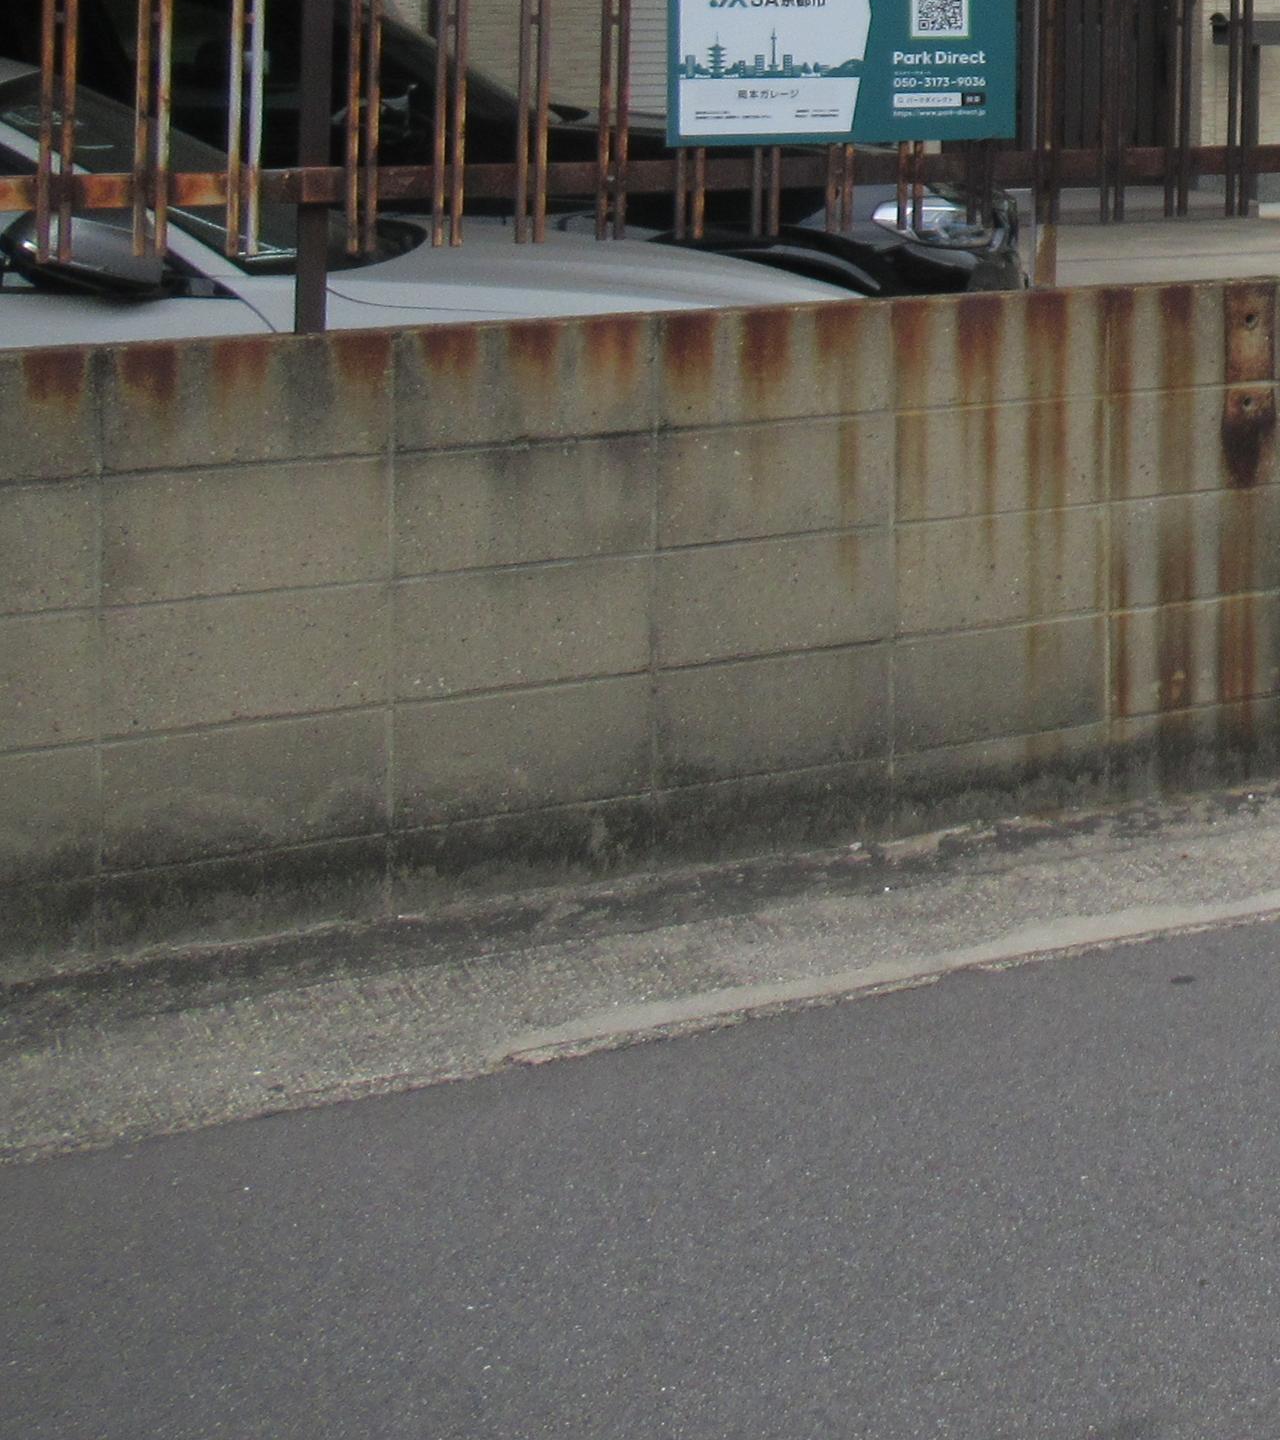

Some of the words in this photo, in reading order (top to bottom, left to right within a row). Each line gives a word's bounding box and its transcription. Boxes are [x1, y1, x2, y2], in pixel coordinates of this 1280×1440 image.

[893, 51, 932, 64] Park
[935, 50, 986, 64] Direct
[894, 76, 986, 88] 050-3173-9036
